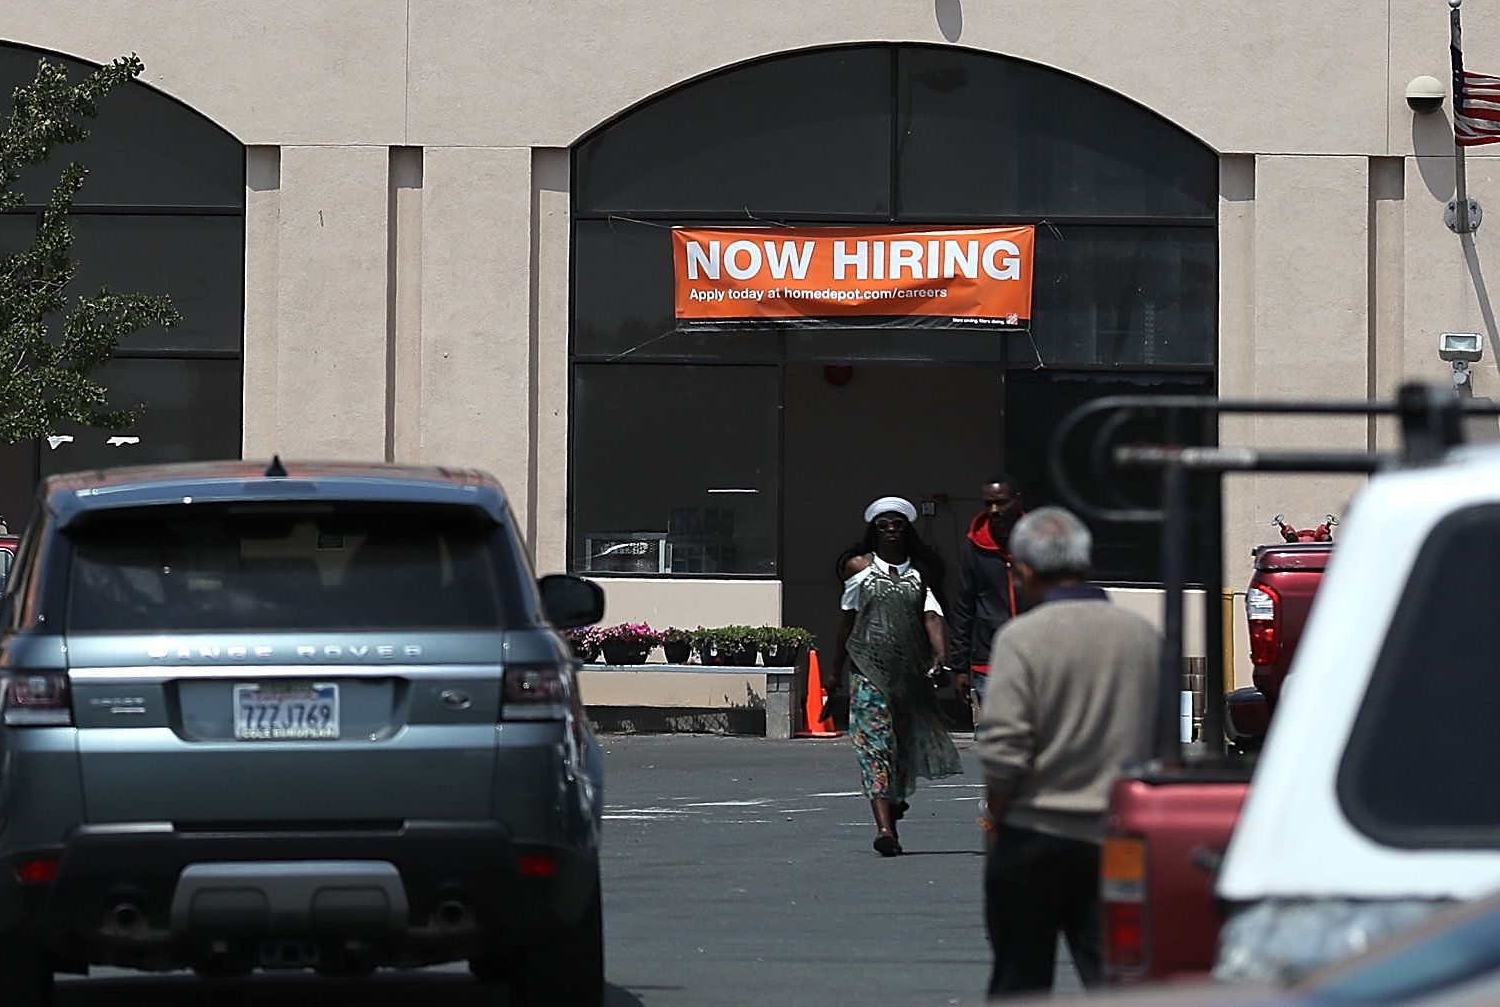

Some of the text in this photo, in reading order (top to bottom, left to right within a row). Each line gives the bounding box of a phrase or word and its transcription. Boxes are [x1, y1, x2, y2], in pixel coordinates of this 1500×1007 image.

[685, 239, 1021, 281] NOW HIRING
[689, 286, 948, 302] Apply today at homedepot.com/careers
[297, 644, 423, 660] ROVER
